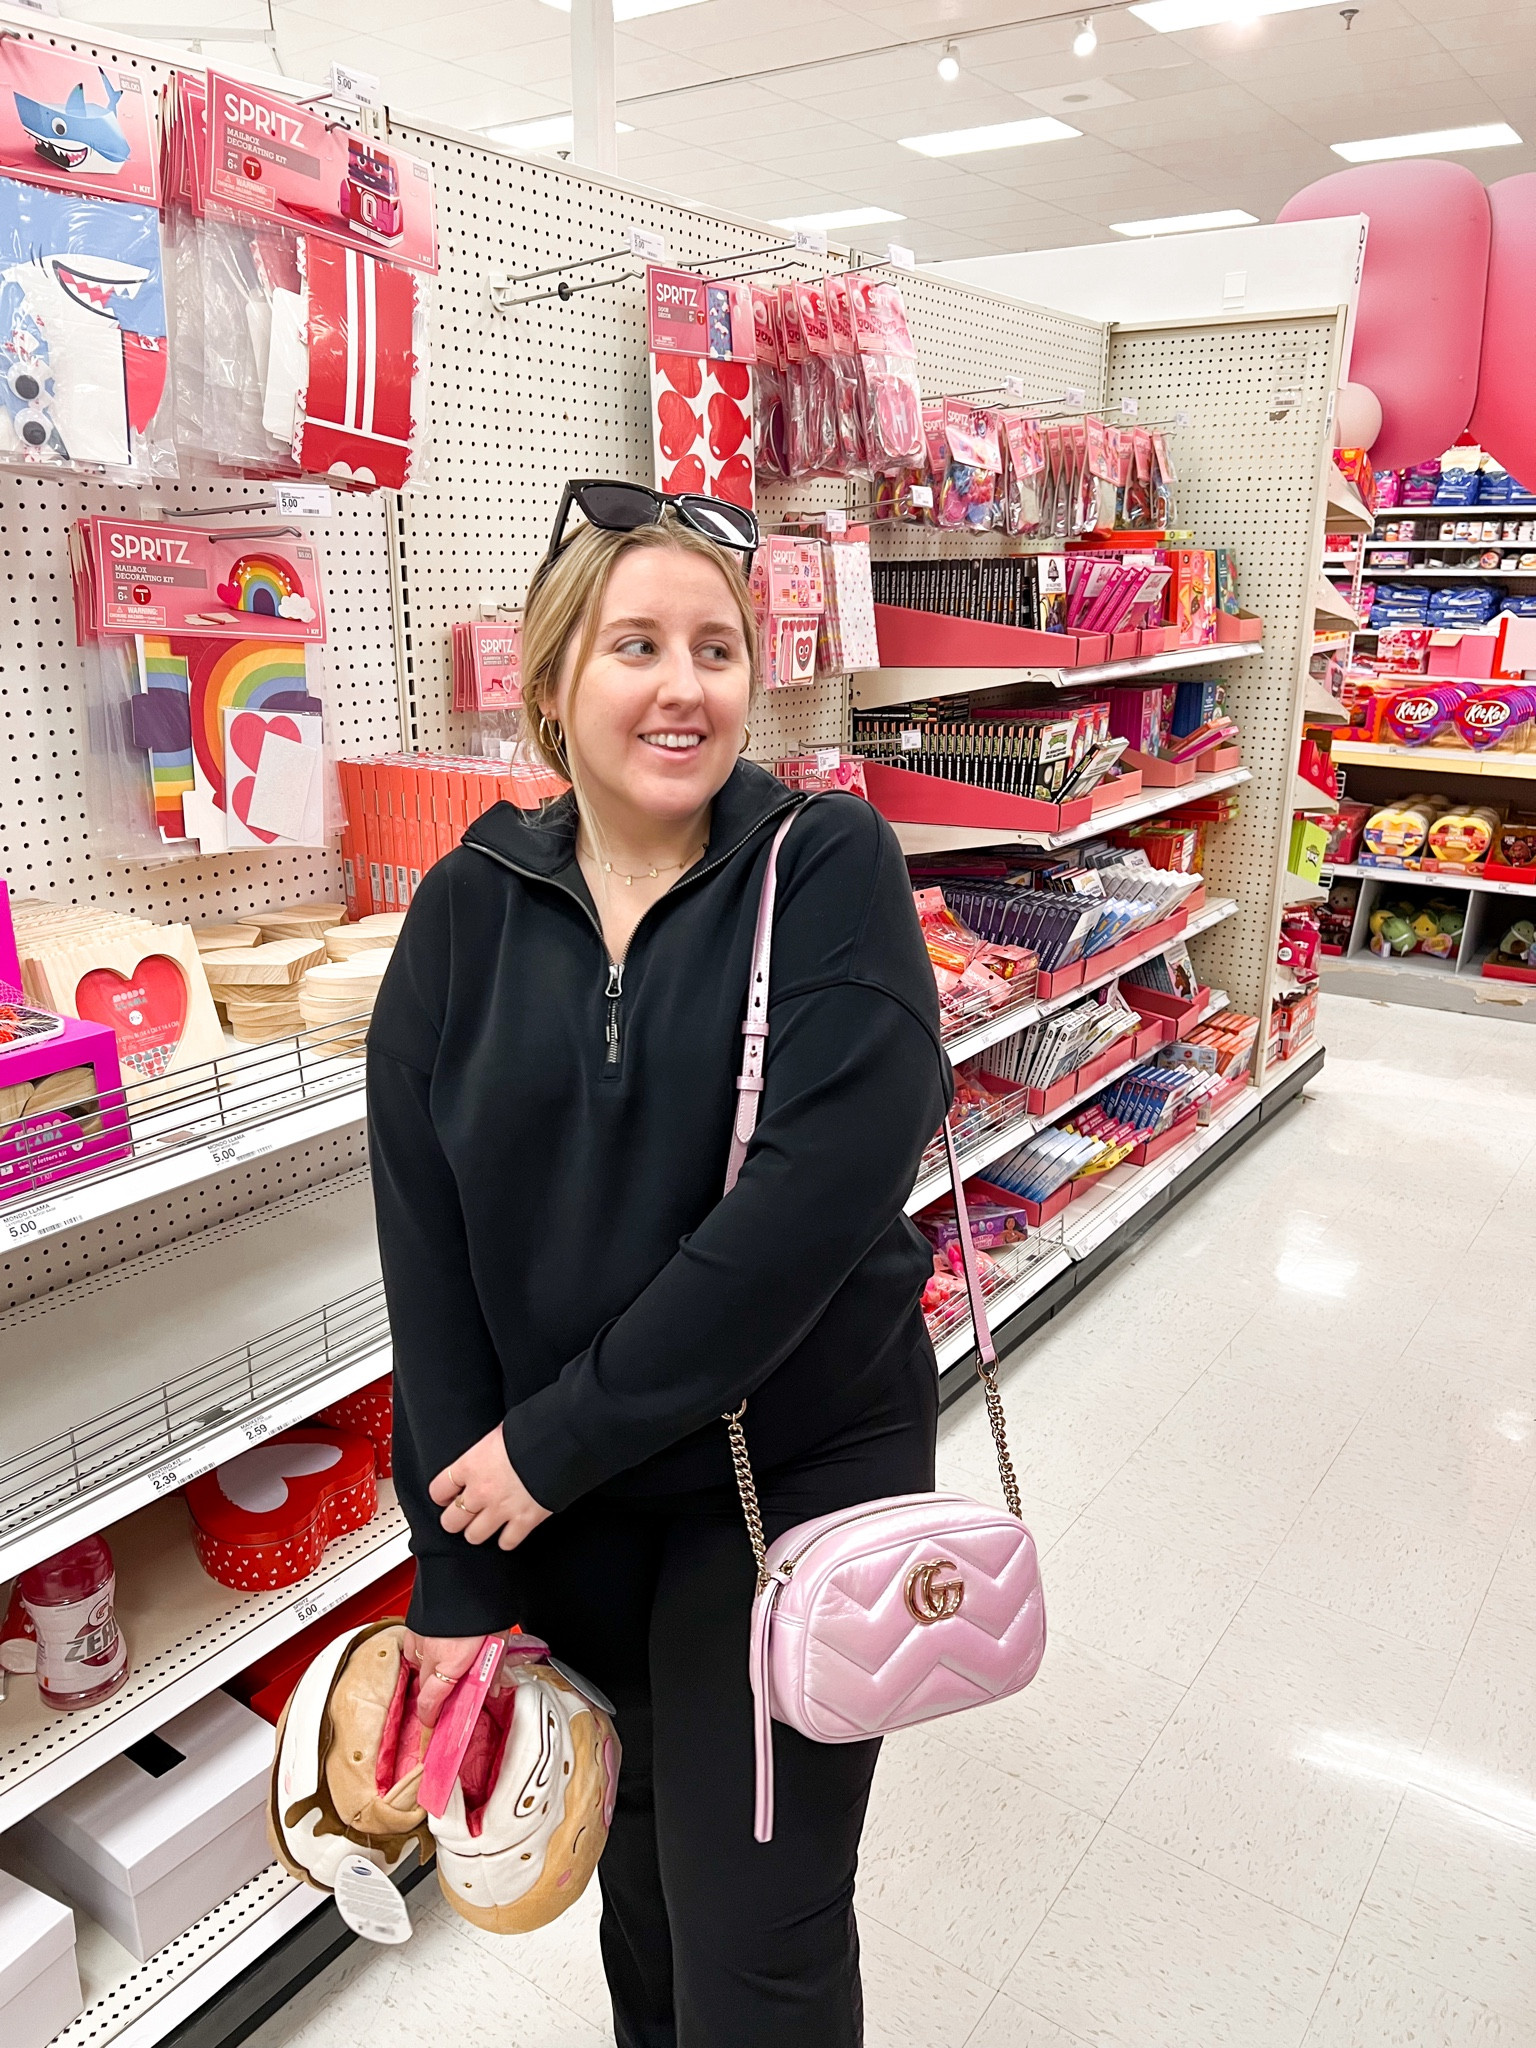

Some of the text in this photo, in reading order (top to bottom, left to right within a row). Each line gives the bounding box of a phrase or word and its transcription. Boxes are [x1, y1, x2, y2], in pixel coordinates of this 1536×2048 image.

[337, 75, 352, 90] 5.00
[224, 93, 305, 149] SPRITZ
[226, 127, 260, 145] MAILBOX
[226, 136, 287, 165] DECORATING KIT
[227, 158, 238, 170] 6+
[250, 166, 256, 177] 1
[132, 183, 151, 194] 1 KIT
[656, 283, 698, 308] SPRITZ
[281, 498, 298, 508] 5.00
[110, 533, 191, 565] SPRITZ
[114, 564, 147, 574] MAILBOX
[115, 572, 174, 584] DECORATING KIT
[117, 592, 128, 601] 6+
[140, 593, 145, 602] 1
[481, 639, 514, 653] SPRITZ
[207, 1134, 246, 1150] MONDO LLAMA
[37, 1153, 58, 1164] letters
[58, 1150, 67, 1158] kit
[213, 1148, 236, 1163] 5.00
[3, 1204, 50, 1223] MONDO LLAMA
[9, 1220, 37, 1238] 5.00
[240, 1414, 264, 1430] MARKERS
[246, 1424, 268, 1440] 2.59
[147, 1463, 173, 1479] PAINTING
[153, 1472, 177, 1490] 2.39
[298, 1604, 318, 1621] 5.00
